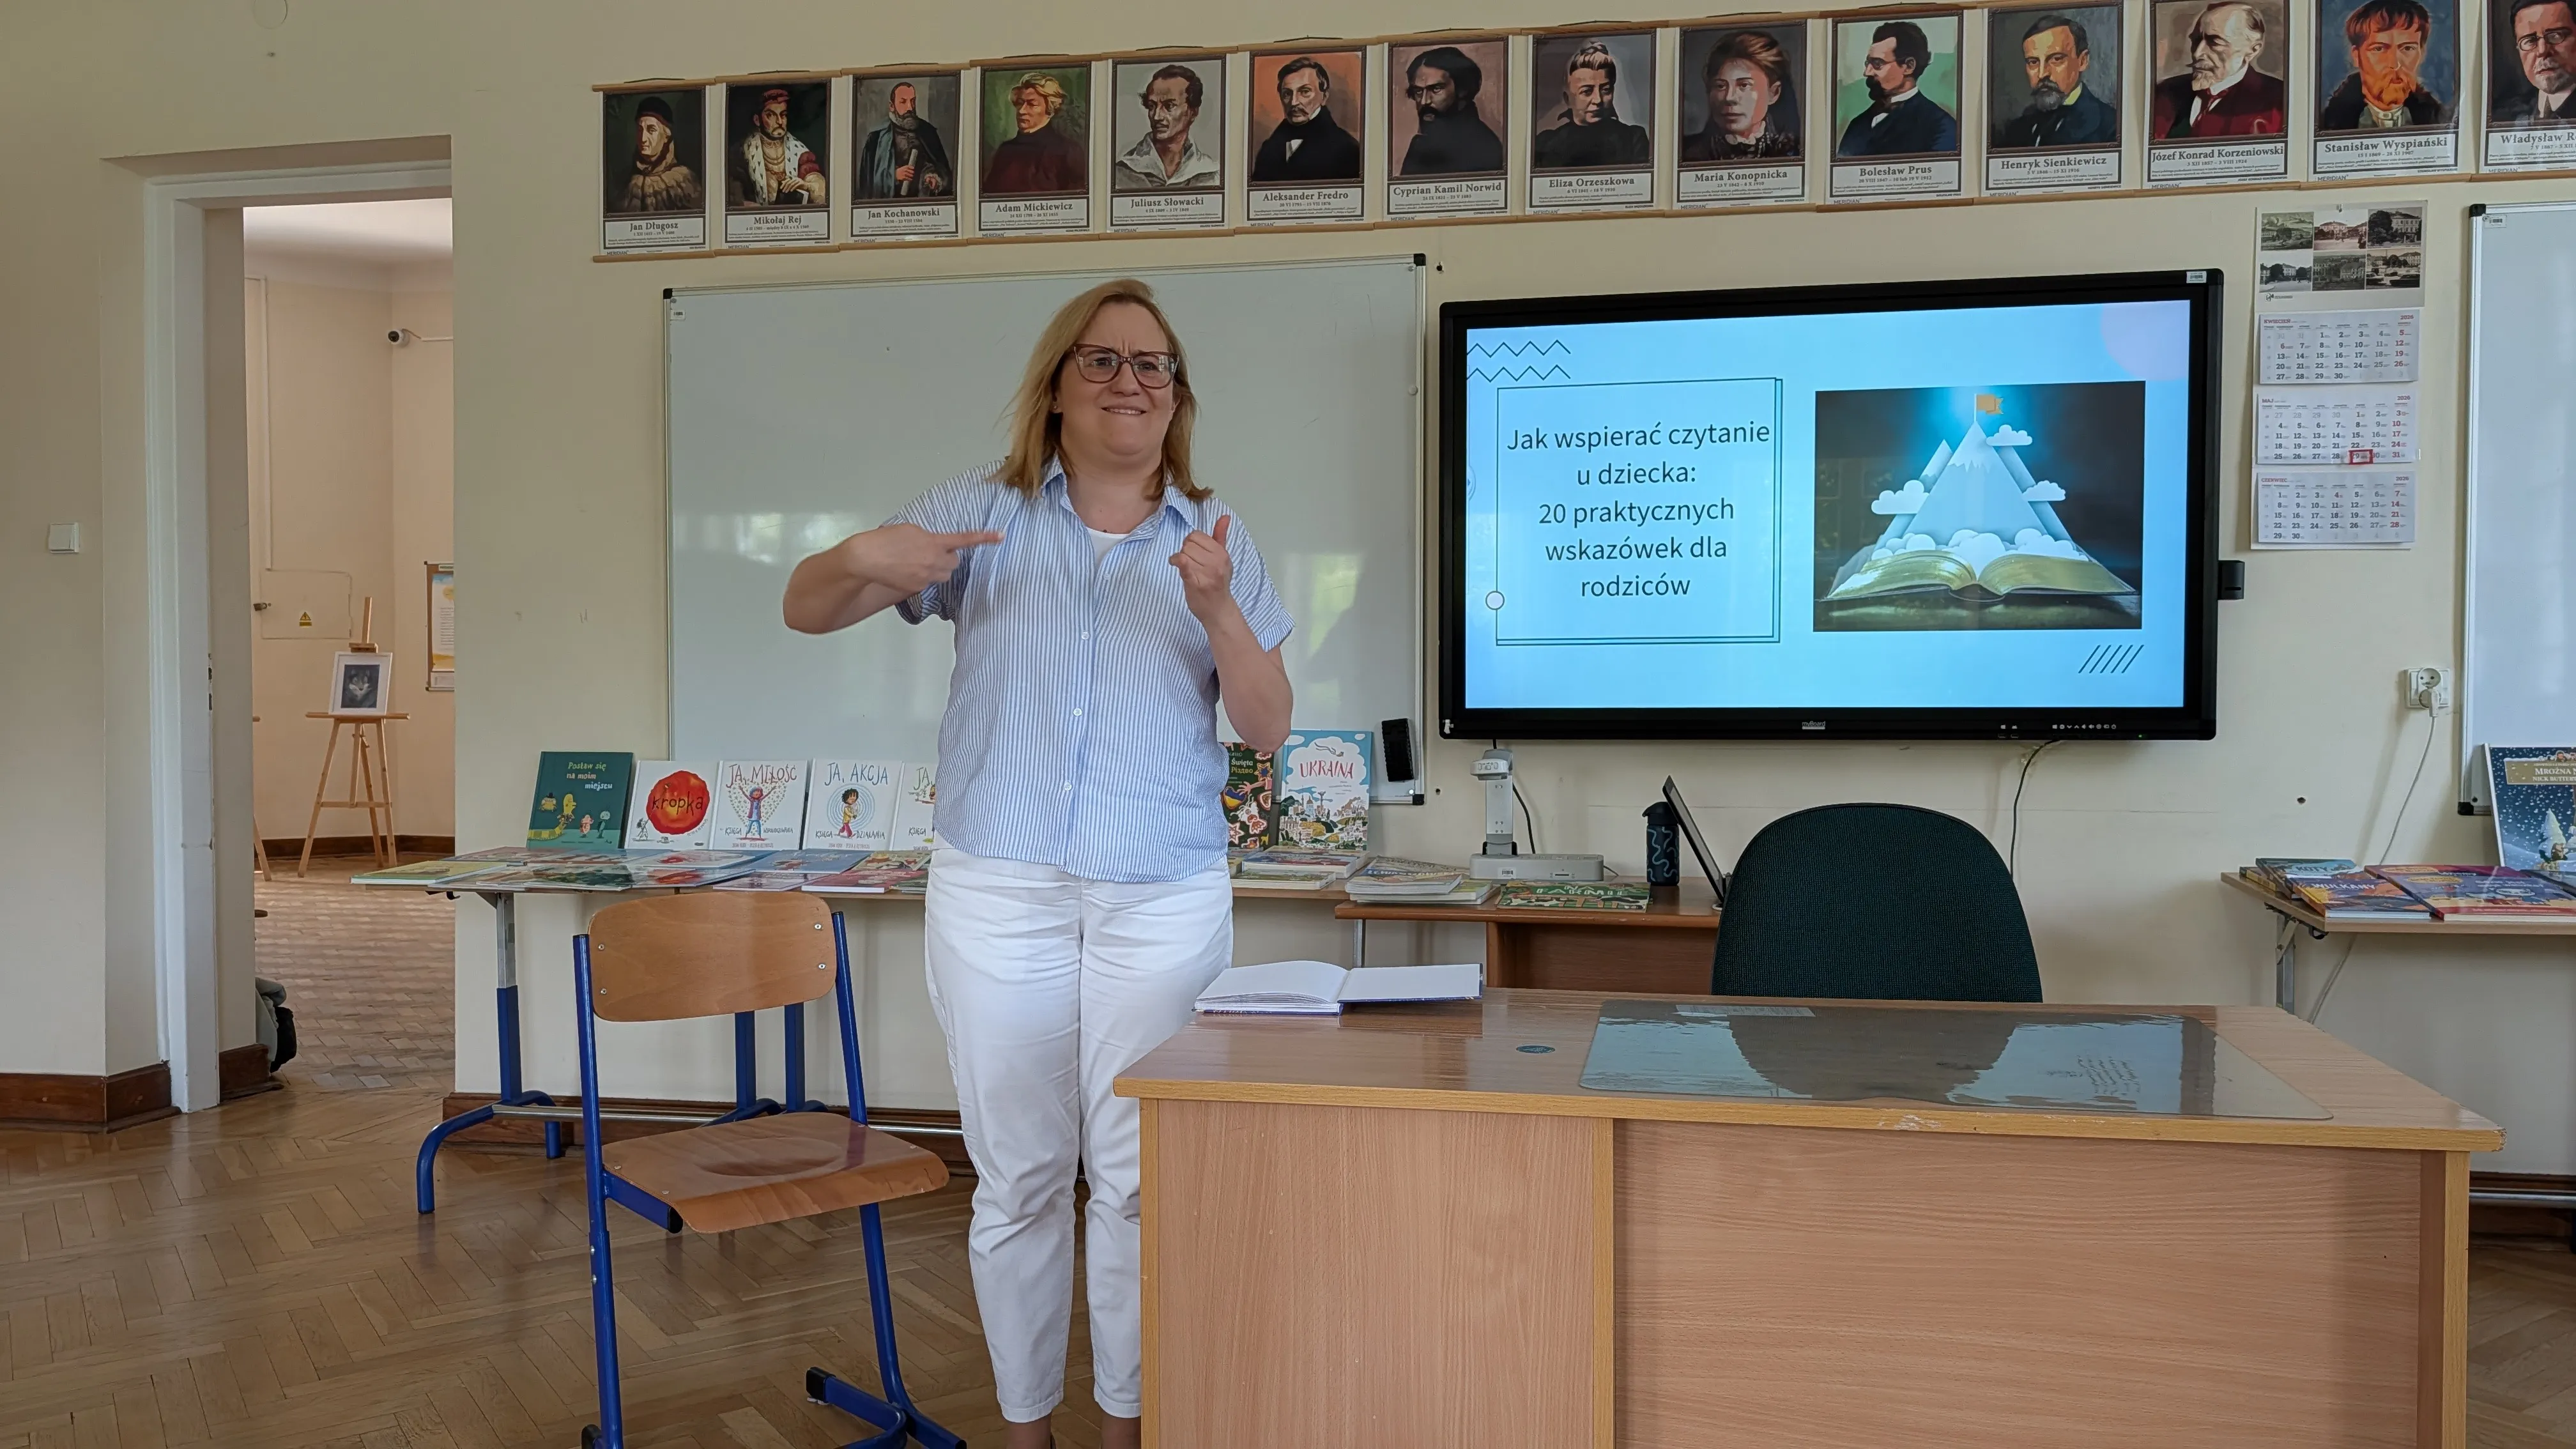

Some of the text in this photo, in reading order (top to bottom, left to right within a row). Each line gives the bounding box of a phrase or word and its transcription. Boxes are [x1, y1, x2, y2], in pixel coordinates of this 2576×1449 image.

[2324, 137, 2448, 153] Stanisław Wyspiański
[2501, 133, 2563, 145] Władysław
[2152, 146, 2283, 163] Józef Konrad Korzeniowski
[2000, 156, 2107, 171] Henryk Sienkiewicz
[1694, 169, 1788, 182] Maria Konopnicka
[1859, 165, 1932, 176] Bolesław Prus
[1549, 176, 1635, 188] Eliza Orzeszkowa
[1262, 190, 1349, 202] Aleksander Fredro
[1393, 182, 1501, 197] Cyprian Kamil Norwid
[995, 203, 1073, 213] Adam Mickiewicz
[1131, 197, 1204, 209] Juliusz Słowacki
[753, 215, 802, 226] Mikołaj Rej
[868, 208, 940, 220] Jan Kochanowski
[629, 222, 678, 232] Jan Długosz
[1506, 421, 1770, 452] Jak wspierać czytanie
[1577, 461, 1696, 485] u dziecka:
[1539, 498, 1734, 528] 20 praktycznych
[1545, 536, 1727, 561] wskazówek dla
[1581, 572, 1690, 597] rodziców
[567, 762, 606, 772] Postaw się
[1230, 757, 1254, 767] Święta
[578, 771, 596, 779] moim
[726, 763, 797, 788] JA, MIŁOŚĆ
[824, 762, 888, 786] JA, AKCJA
[1300, 760, 1354, 779] UKRAINA
[2534, 767, 2572, 775] MROŹNA
[913, 767, 933, 791] JA,
[585, 781, 613, 792] miejscu
[652, 791, 703, 816] kropka
